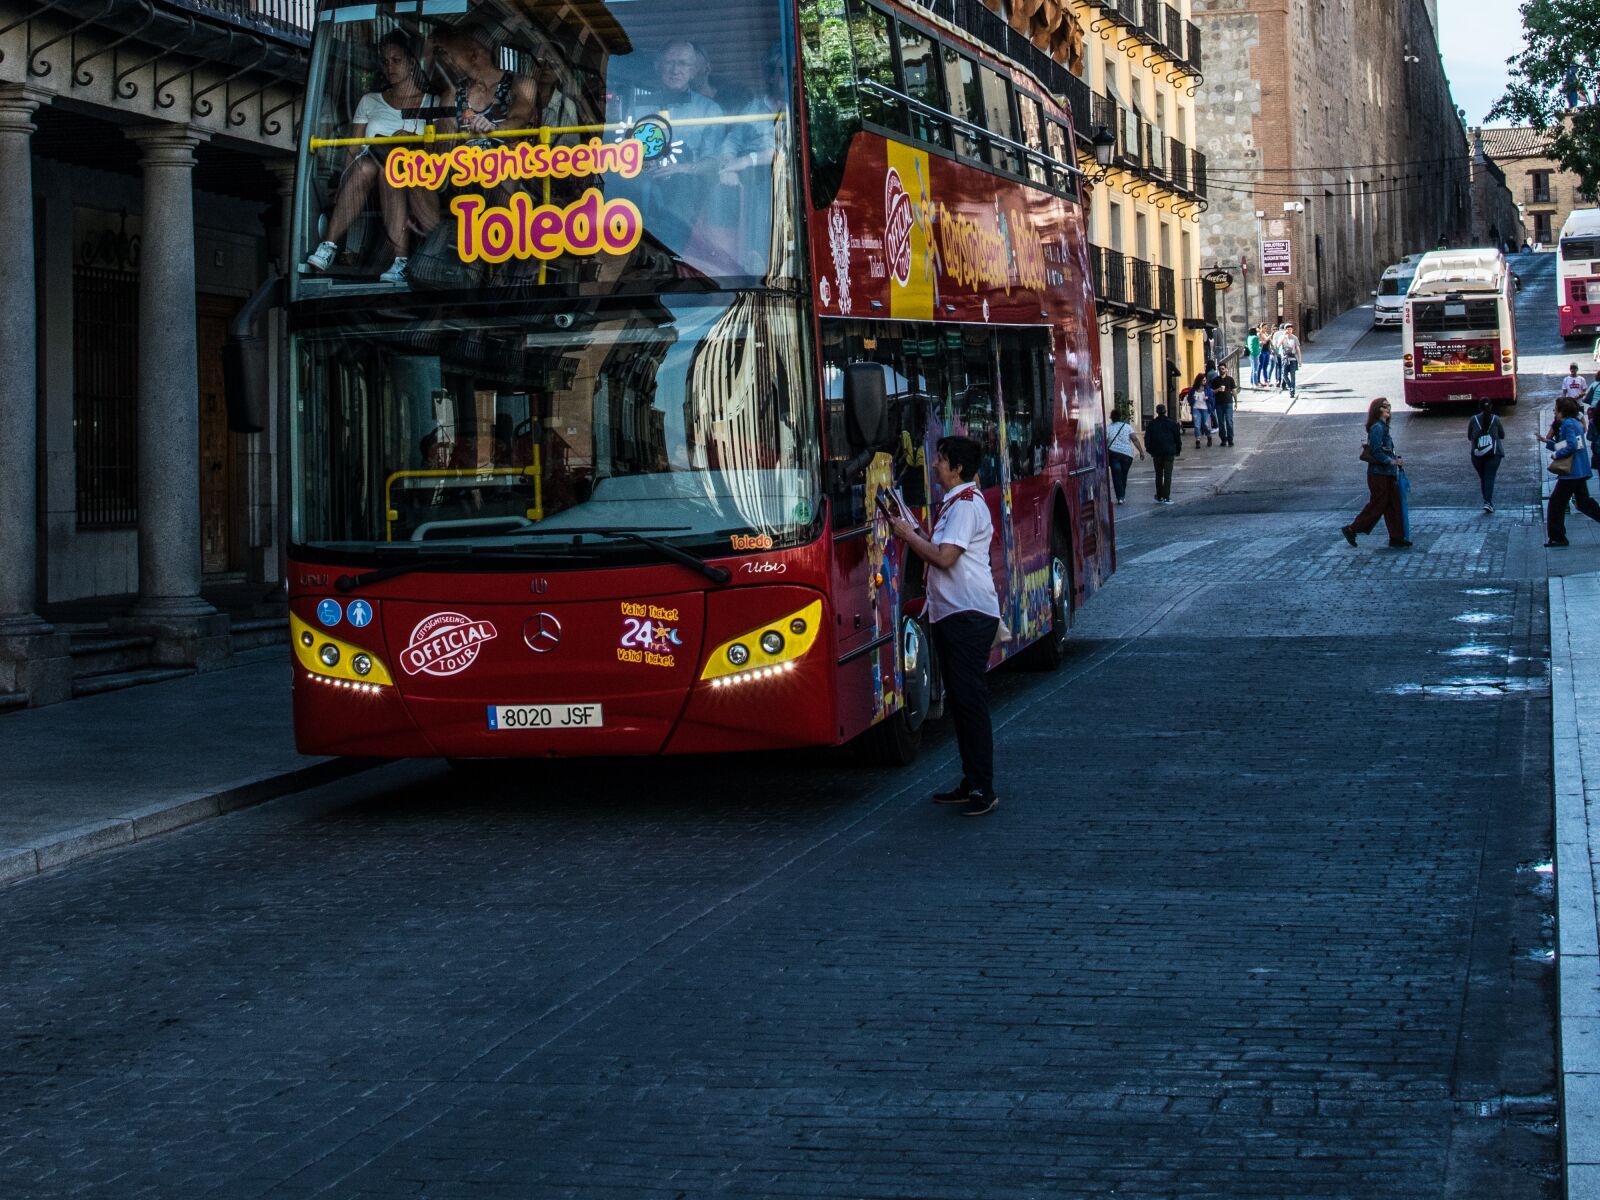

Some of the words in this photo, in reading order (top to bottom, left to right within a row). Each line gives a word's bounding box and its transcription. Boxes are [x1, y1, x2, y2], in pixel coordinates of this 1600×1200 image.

[385, 147, 449, 190] City
[451, 137, 643, 188] Sightseeing
[449, 187, 643, 263] Toledo
[730, 533, 773, 550] Toledo
[621, 602, 647, 617] Valid
[648, 605, 679, 621] Ticket
[621, 618, 653, 648] 24
[410, 623, 492, 667] OFFICIAL
[439, 648, 475, 670] TOUR
[616, 648, 643, 663] Valid
[644, 651, 675, 667] Ticket
[504, 708, 552, 727] 8020
[561, 706, 594, 725] JSF
